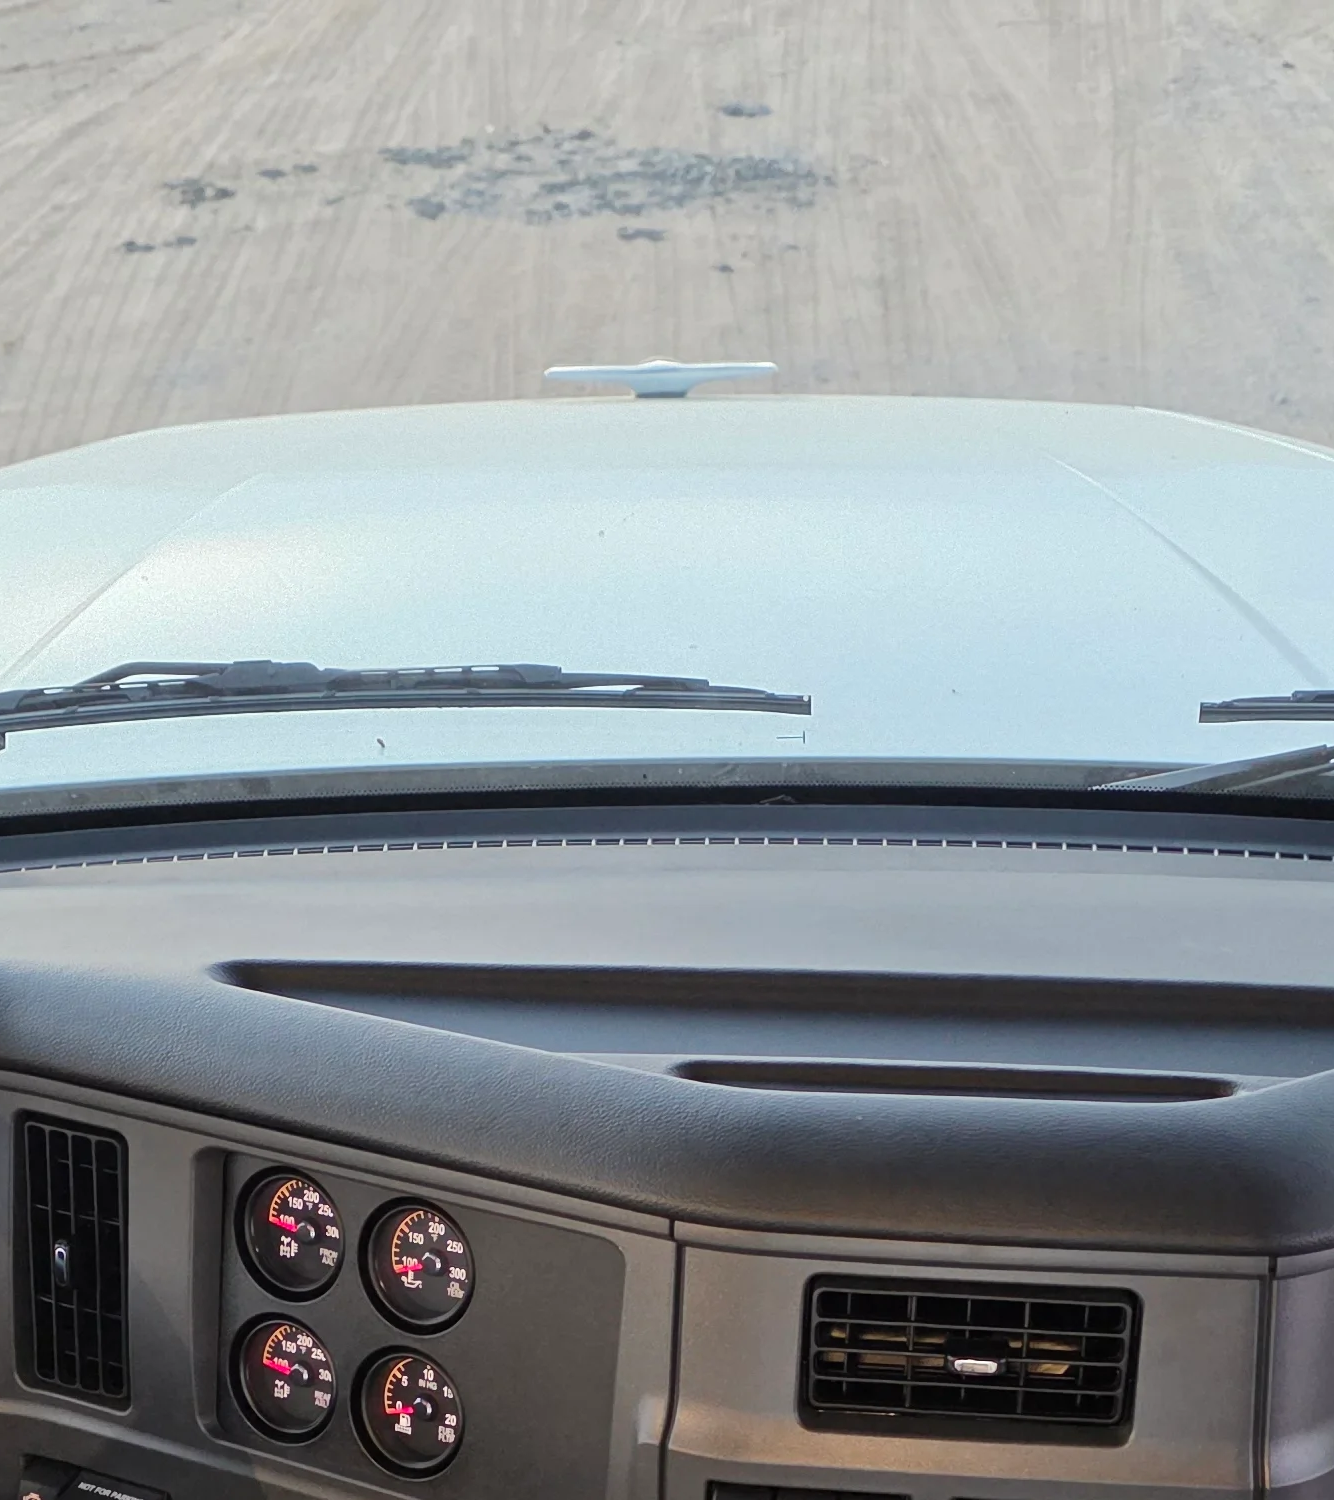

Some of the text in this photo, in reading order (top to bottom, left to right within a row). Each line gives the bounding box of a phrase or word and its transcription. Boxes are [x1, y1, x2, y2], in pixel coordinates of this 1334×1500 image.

[287, 1196, 303, 1209] 150
[304, 1189, 320, 1203] 200
[428, 1222, 445, 1235] 200
[408, 1232, 424, 1245] 150
[447, 1240, 464, 1254] 250
[449, 1267, 466, 1280] 300
[281, 1340, 297, 1353] 150
[296, 1334, 313, 1348] 200
[401, 1375, 408, 1387] 5
[423, 1368, 434, 1381] 10
[395, 1400, 403, 1411] 0
[444, 1413, 457, 1427] 20
[77, 1481, 96, 1492] NOT
[93, 1486, 112, 1497] FOR
